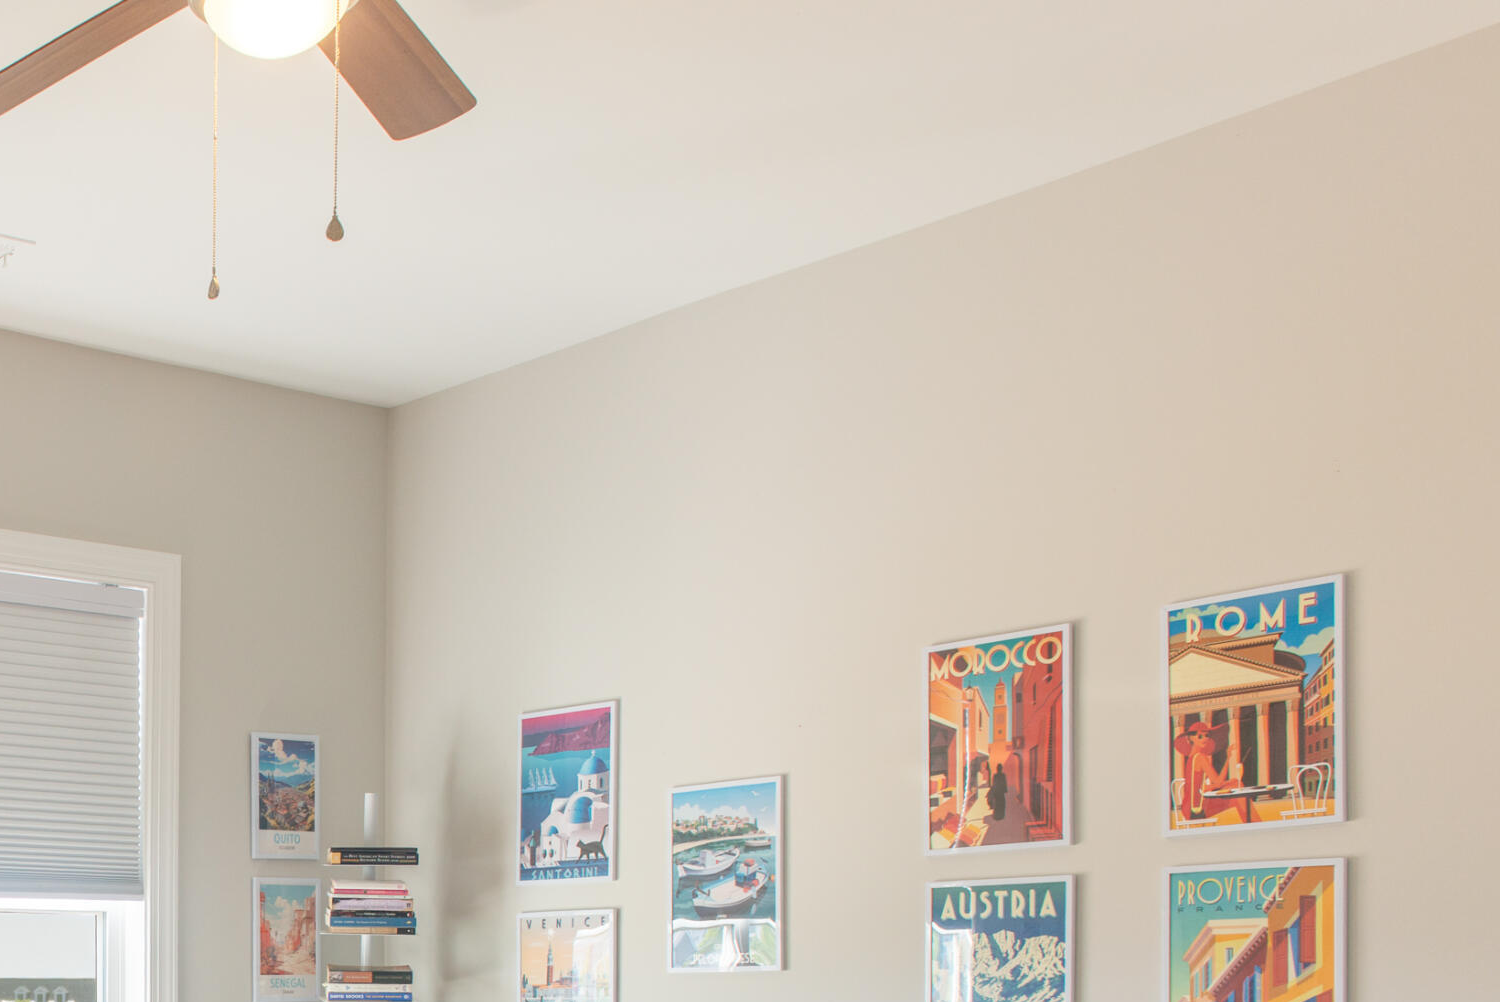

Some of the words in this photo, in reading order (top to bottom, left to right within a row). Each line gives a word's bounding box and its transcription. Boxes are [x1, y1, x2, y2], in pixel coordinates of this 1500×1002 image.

[1185, 591, 1318, 643] ROME
[929, 636, 1062, 682] MOROCCO
[273, 833, 301, 845] QUITO
[531, 866, 600, 880] SANTORINI
[1178, 874, 1285, 905] PROVENCE
[940, 888, 1057, 920] AUSTRIA
[1177, 901, 1284, 913] FRANCE
[526, 916, 605, 929] VENICE
[269, 978, 306, 989] SENEGAL
